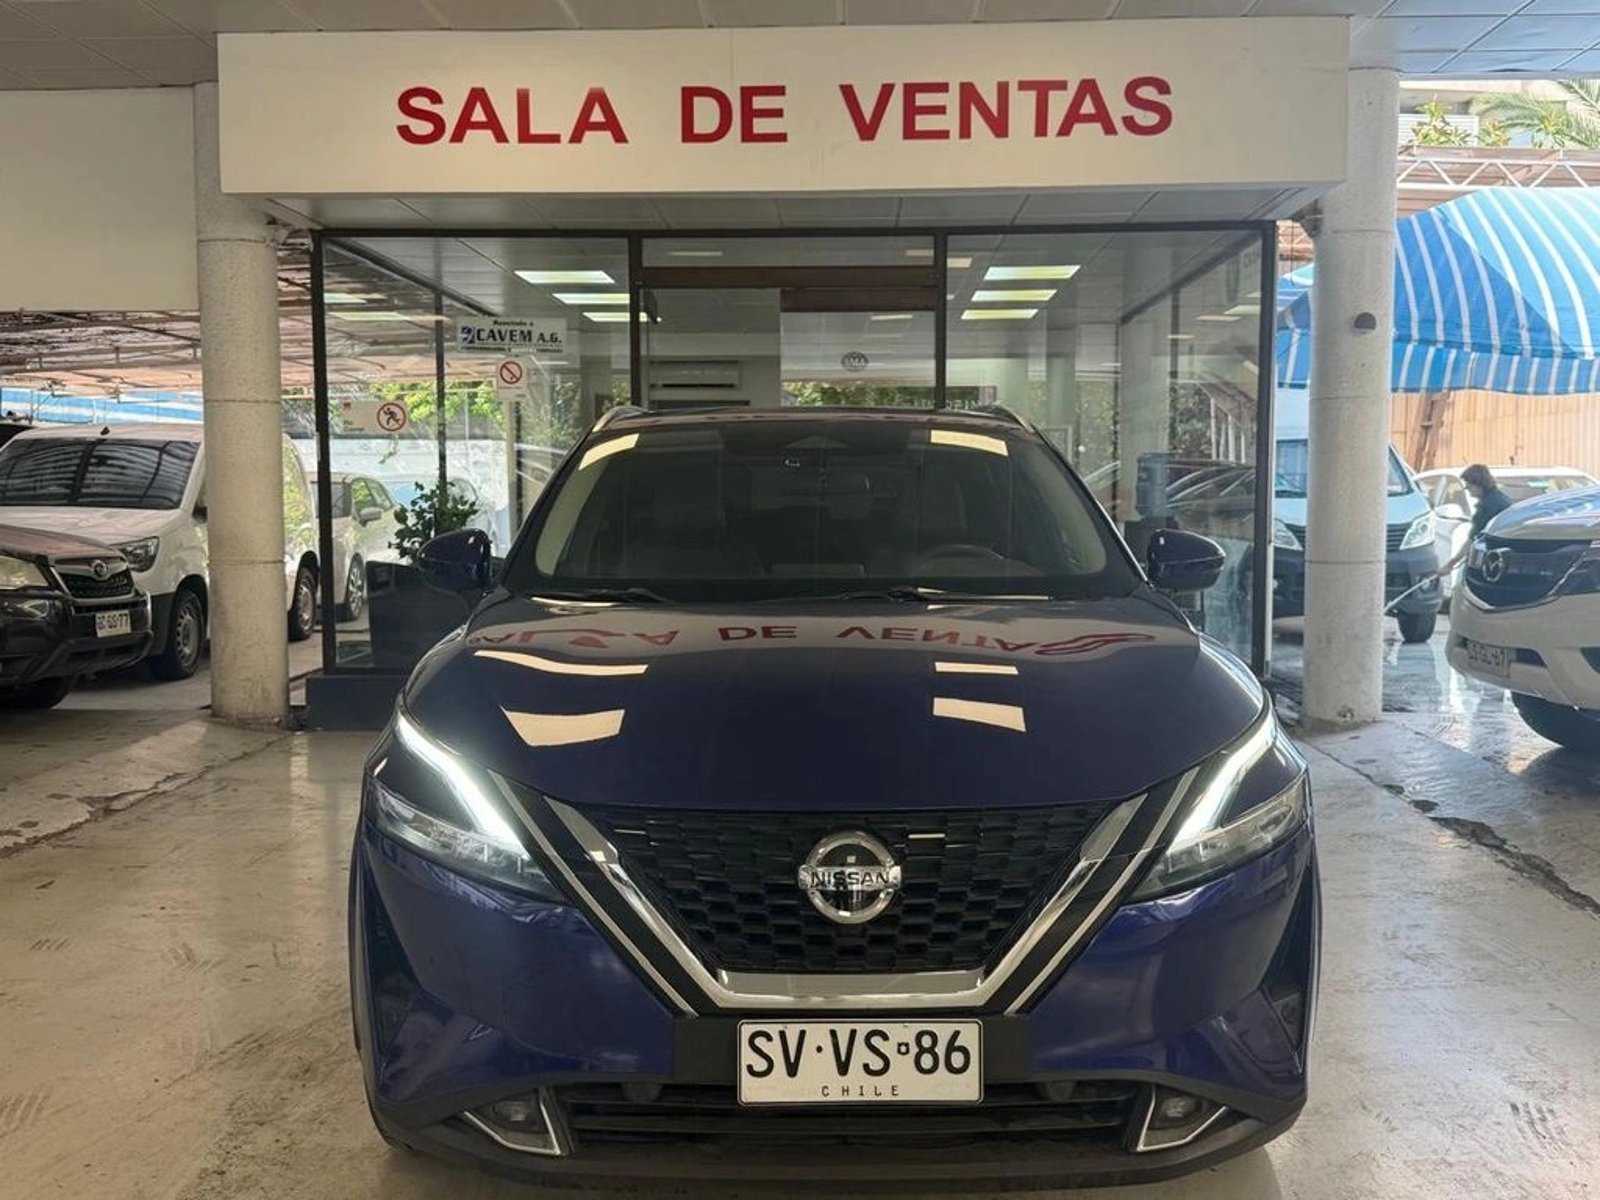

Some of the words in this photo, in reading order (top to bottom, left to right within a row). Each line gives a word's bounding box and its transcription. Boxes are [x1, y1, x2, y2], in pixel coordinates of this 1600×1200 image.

[396, 86, 629, 145] SALA
[681, 85, 788, 143] DE
[838, 76, 1173, 142] VENTAS
[476, 328, 532, 343] CAVEM
[536, 332, 562, 343] A.G.
[810, 870, 890, 888] NISSAN
[821, 1085, 899, 1097] CHILE
